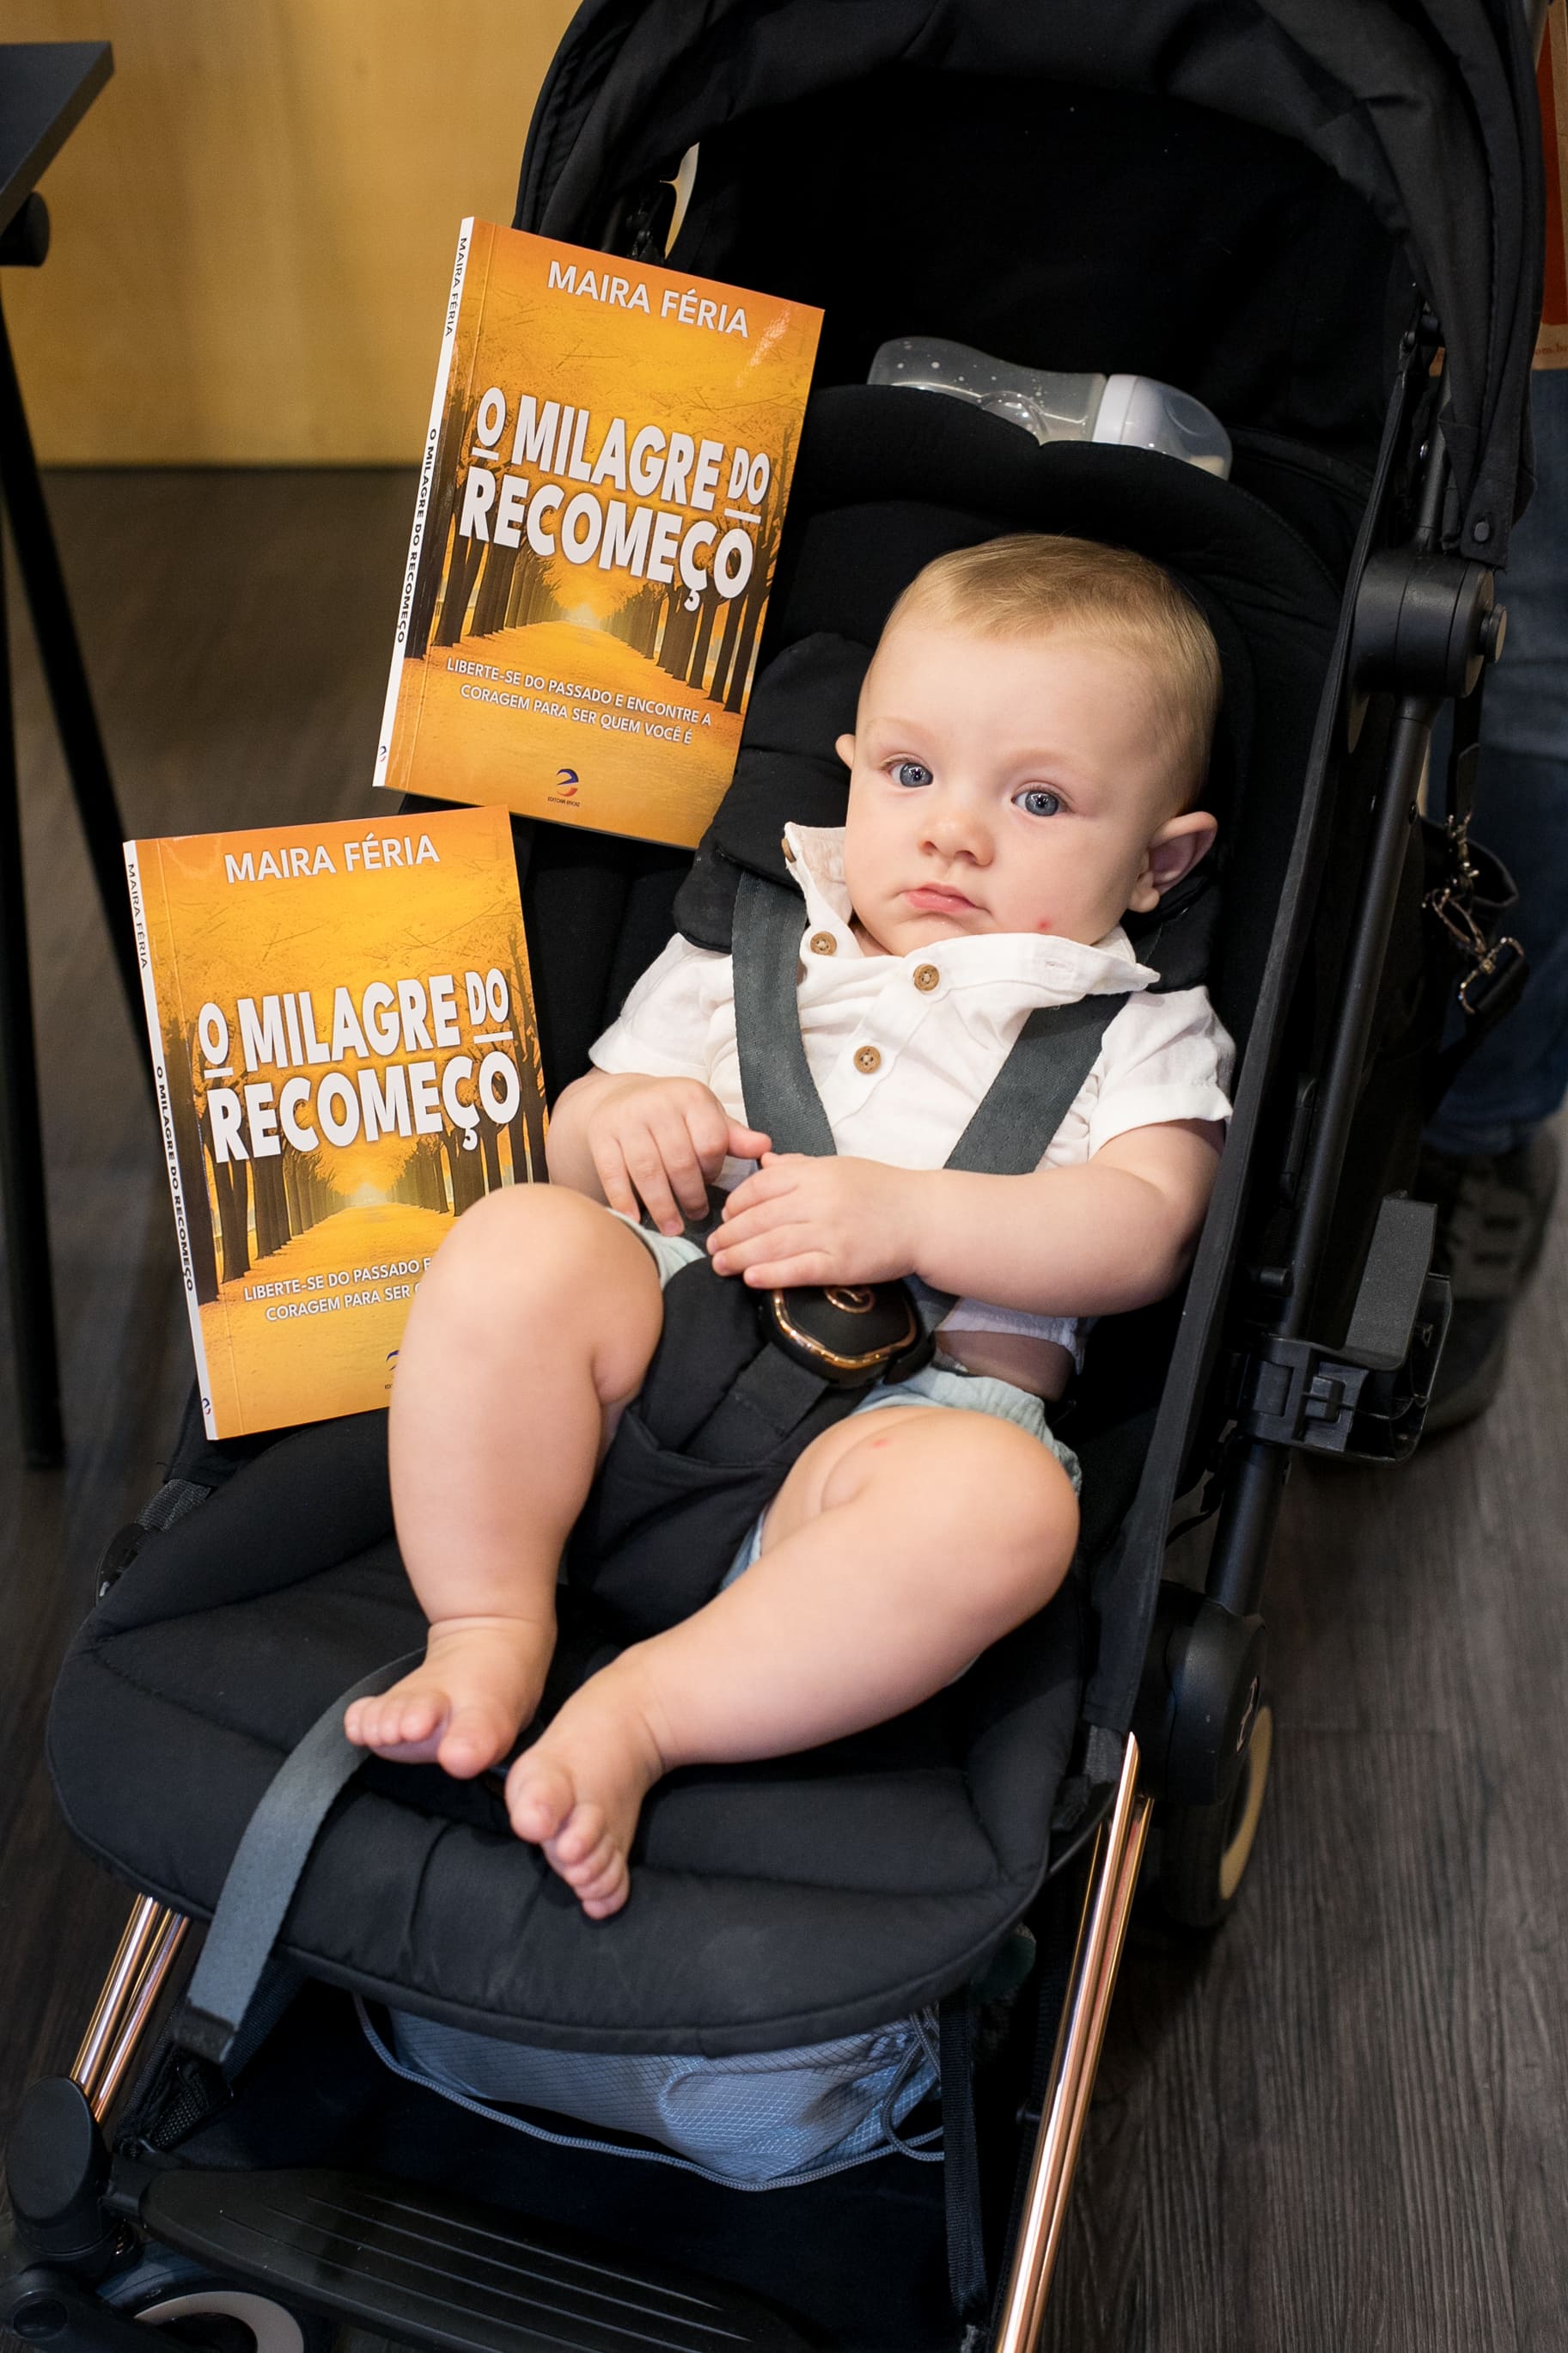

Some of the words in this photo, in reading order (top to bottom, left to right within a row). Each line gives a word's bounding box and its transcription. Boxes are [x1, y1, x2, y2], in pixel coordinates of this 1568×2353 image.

[452, 236, 468, 289] MAIRA
[444, 292, 459, 338] FÉRIA
[547, 260, 650, 314] MAIRA
[661, 289, 748, 338] FÉRIA
[429, 428, 436, 440] O
[477, 386, 507, 448] O
[511, 394, 724, 511] MILAGRE
[729, 447, 771, 506] DO
[417, 445, 435, 519] MILAGRE
[412, 523, 422, 546] DO
[459, 466, 753, 611] RECOMEÇO
[398, 552, 417, 643] RECOMEÇO
[447, 657, 521, 686] LIBERTE-SE
[524, 674, 546, 691] DO
[548, 680, 612, 705] PASSADO
[614, 693, 623, 707] E
[626, 695, 699, 724] ENCONTRE
[701, 712, 712, 726] A
[460, 684, 530, 711] CORAGEM
[533, 700, 568, 718] PARA
[571, 707, 596, 725] SER
[601, 713, 641, 733] QUEM
[644, 722, 680, 742] VOCÊ
[683, 730, 692, 744] É
[224, 845, 336, 884] MAIRA
[344, 832, 440, 871] FÉRIA
[128, 863, 141, 917] MAIRA
[137, 922, 148, 969] FÉRIA
[198, 1002, 229, 1065] O
[237, 975, 461, 1072] MILAGRE
[465, 968, 509, 1026] DO
[156, 1066, 163, 1078] O
[158, 1084, 175, 1164] MILAGRE
[207, 1051, 521, 1164] RECOMEÇO
[170, 1166, 179, 1190] DO
[174, 1195, 193, 1291] RECOMEÇO
[244, 1273, 324, 1302] LIBERTE-SE
[328, 1270, 350, 1287] DO
[353, 1260, 419, 1283] PASSADO
[265, 1296, 339, 1322] CORAGEM
[344, 1290, 381, 1309] PARA
[385, 1285, 411, 1301] SER
